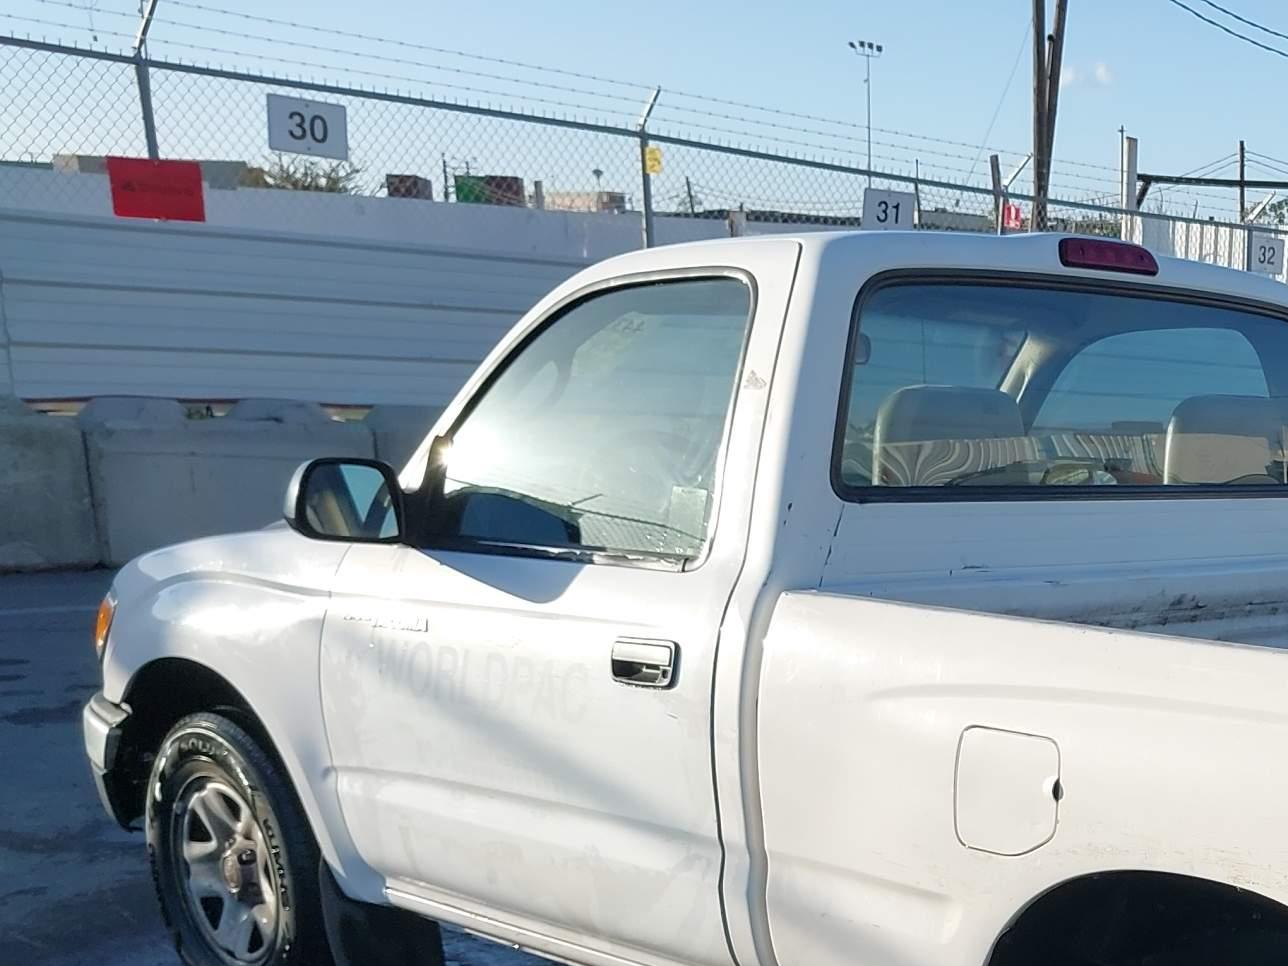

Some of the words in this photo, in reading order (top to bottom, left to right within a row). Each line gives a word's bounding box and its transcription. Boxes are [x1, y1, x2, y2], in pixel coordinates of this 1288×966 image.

[287, 111, 328, 144] 30
[876, 200, 900, 224] 31
[1258, 245, 1276, 265] 32
